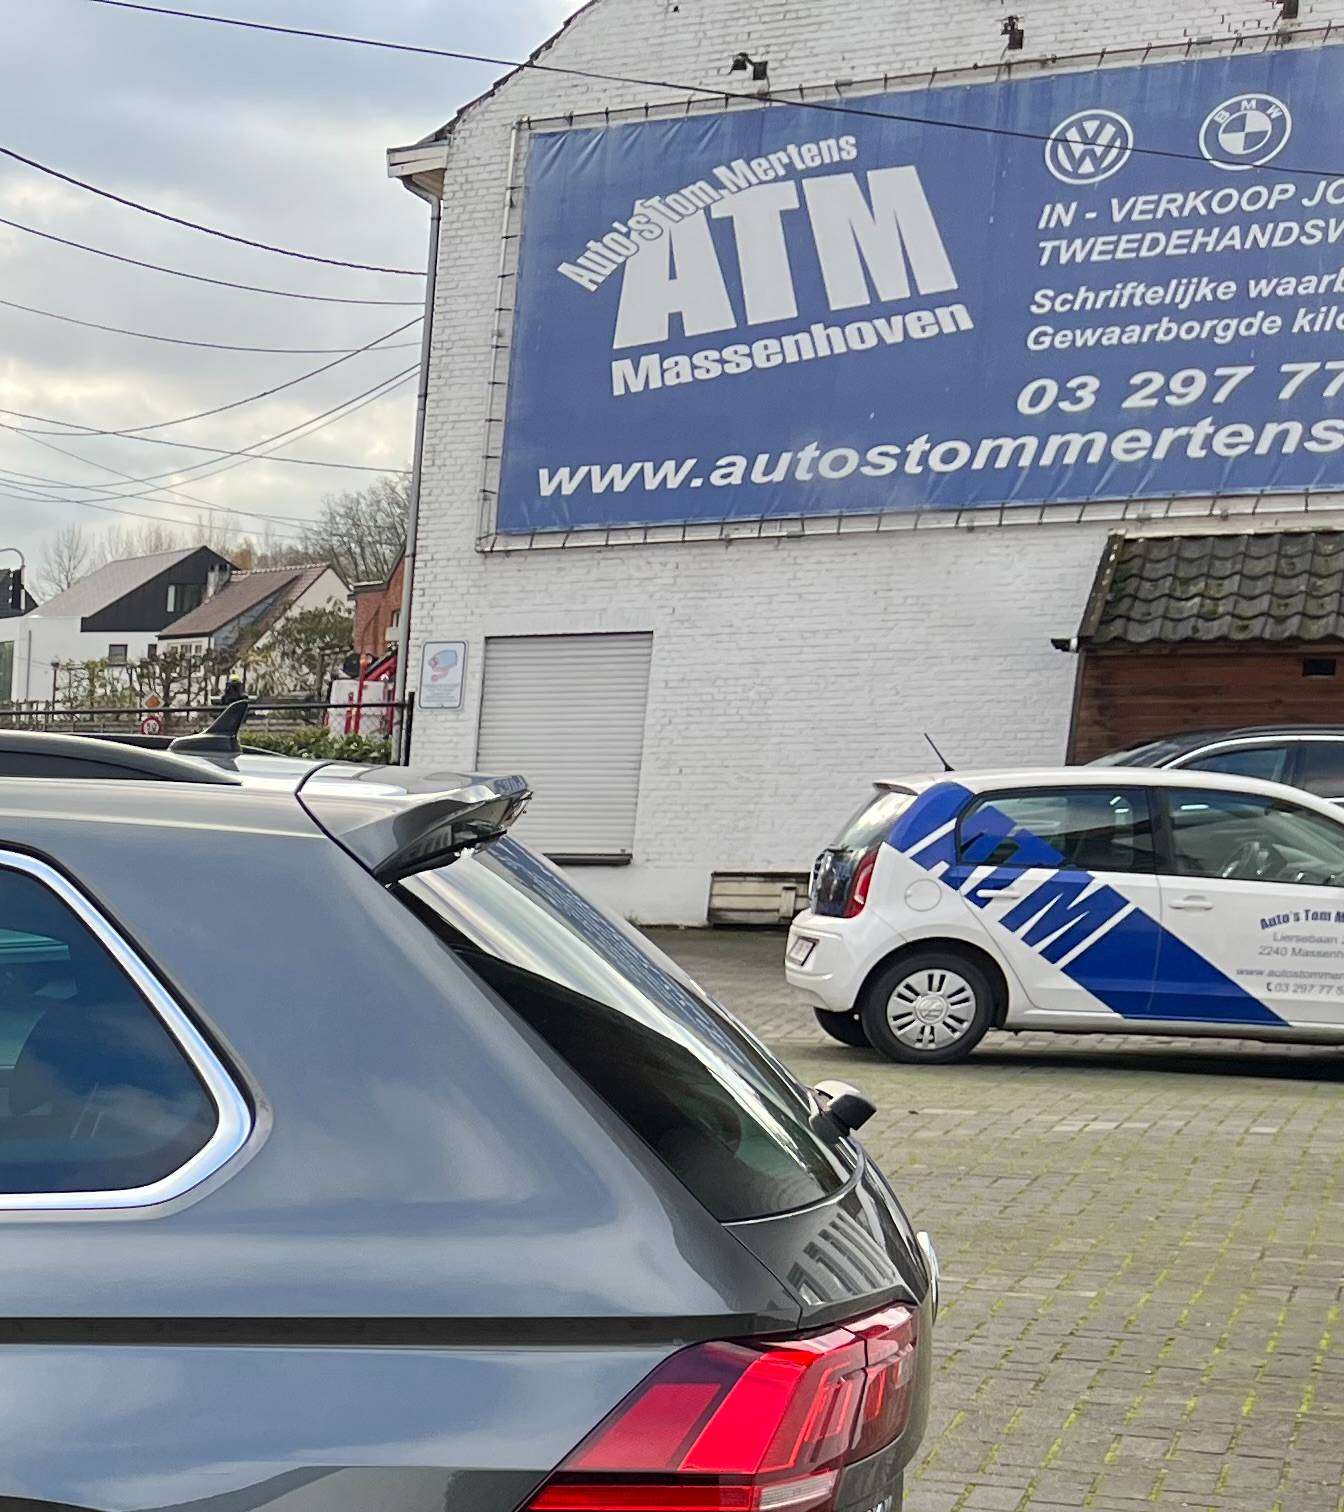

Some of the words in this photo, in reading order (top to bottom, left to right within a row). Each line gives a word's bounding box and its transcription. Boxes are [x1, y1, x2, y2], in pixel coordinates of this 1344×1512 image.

[557, 212, 664, 292] Auto's
[714, 135, 858, 191] Mertens
[1038, 202, 1078, 230] IN
[1110, 183, 1296, 223] VERKOOP
[613, 165, 959, 349] ATM
[1029, 277, 1237, 315] Schriftelijke
[610, 302, 974, 397] Massenhoven
[1026, 311, 1282, 351] Gewaarborgde
[1016, 377, 1100, 416] 03
[1121, 367, 1256, 410] 297
[537, 416, 1344, 497] www.autostommertens
